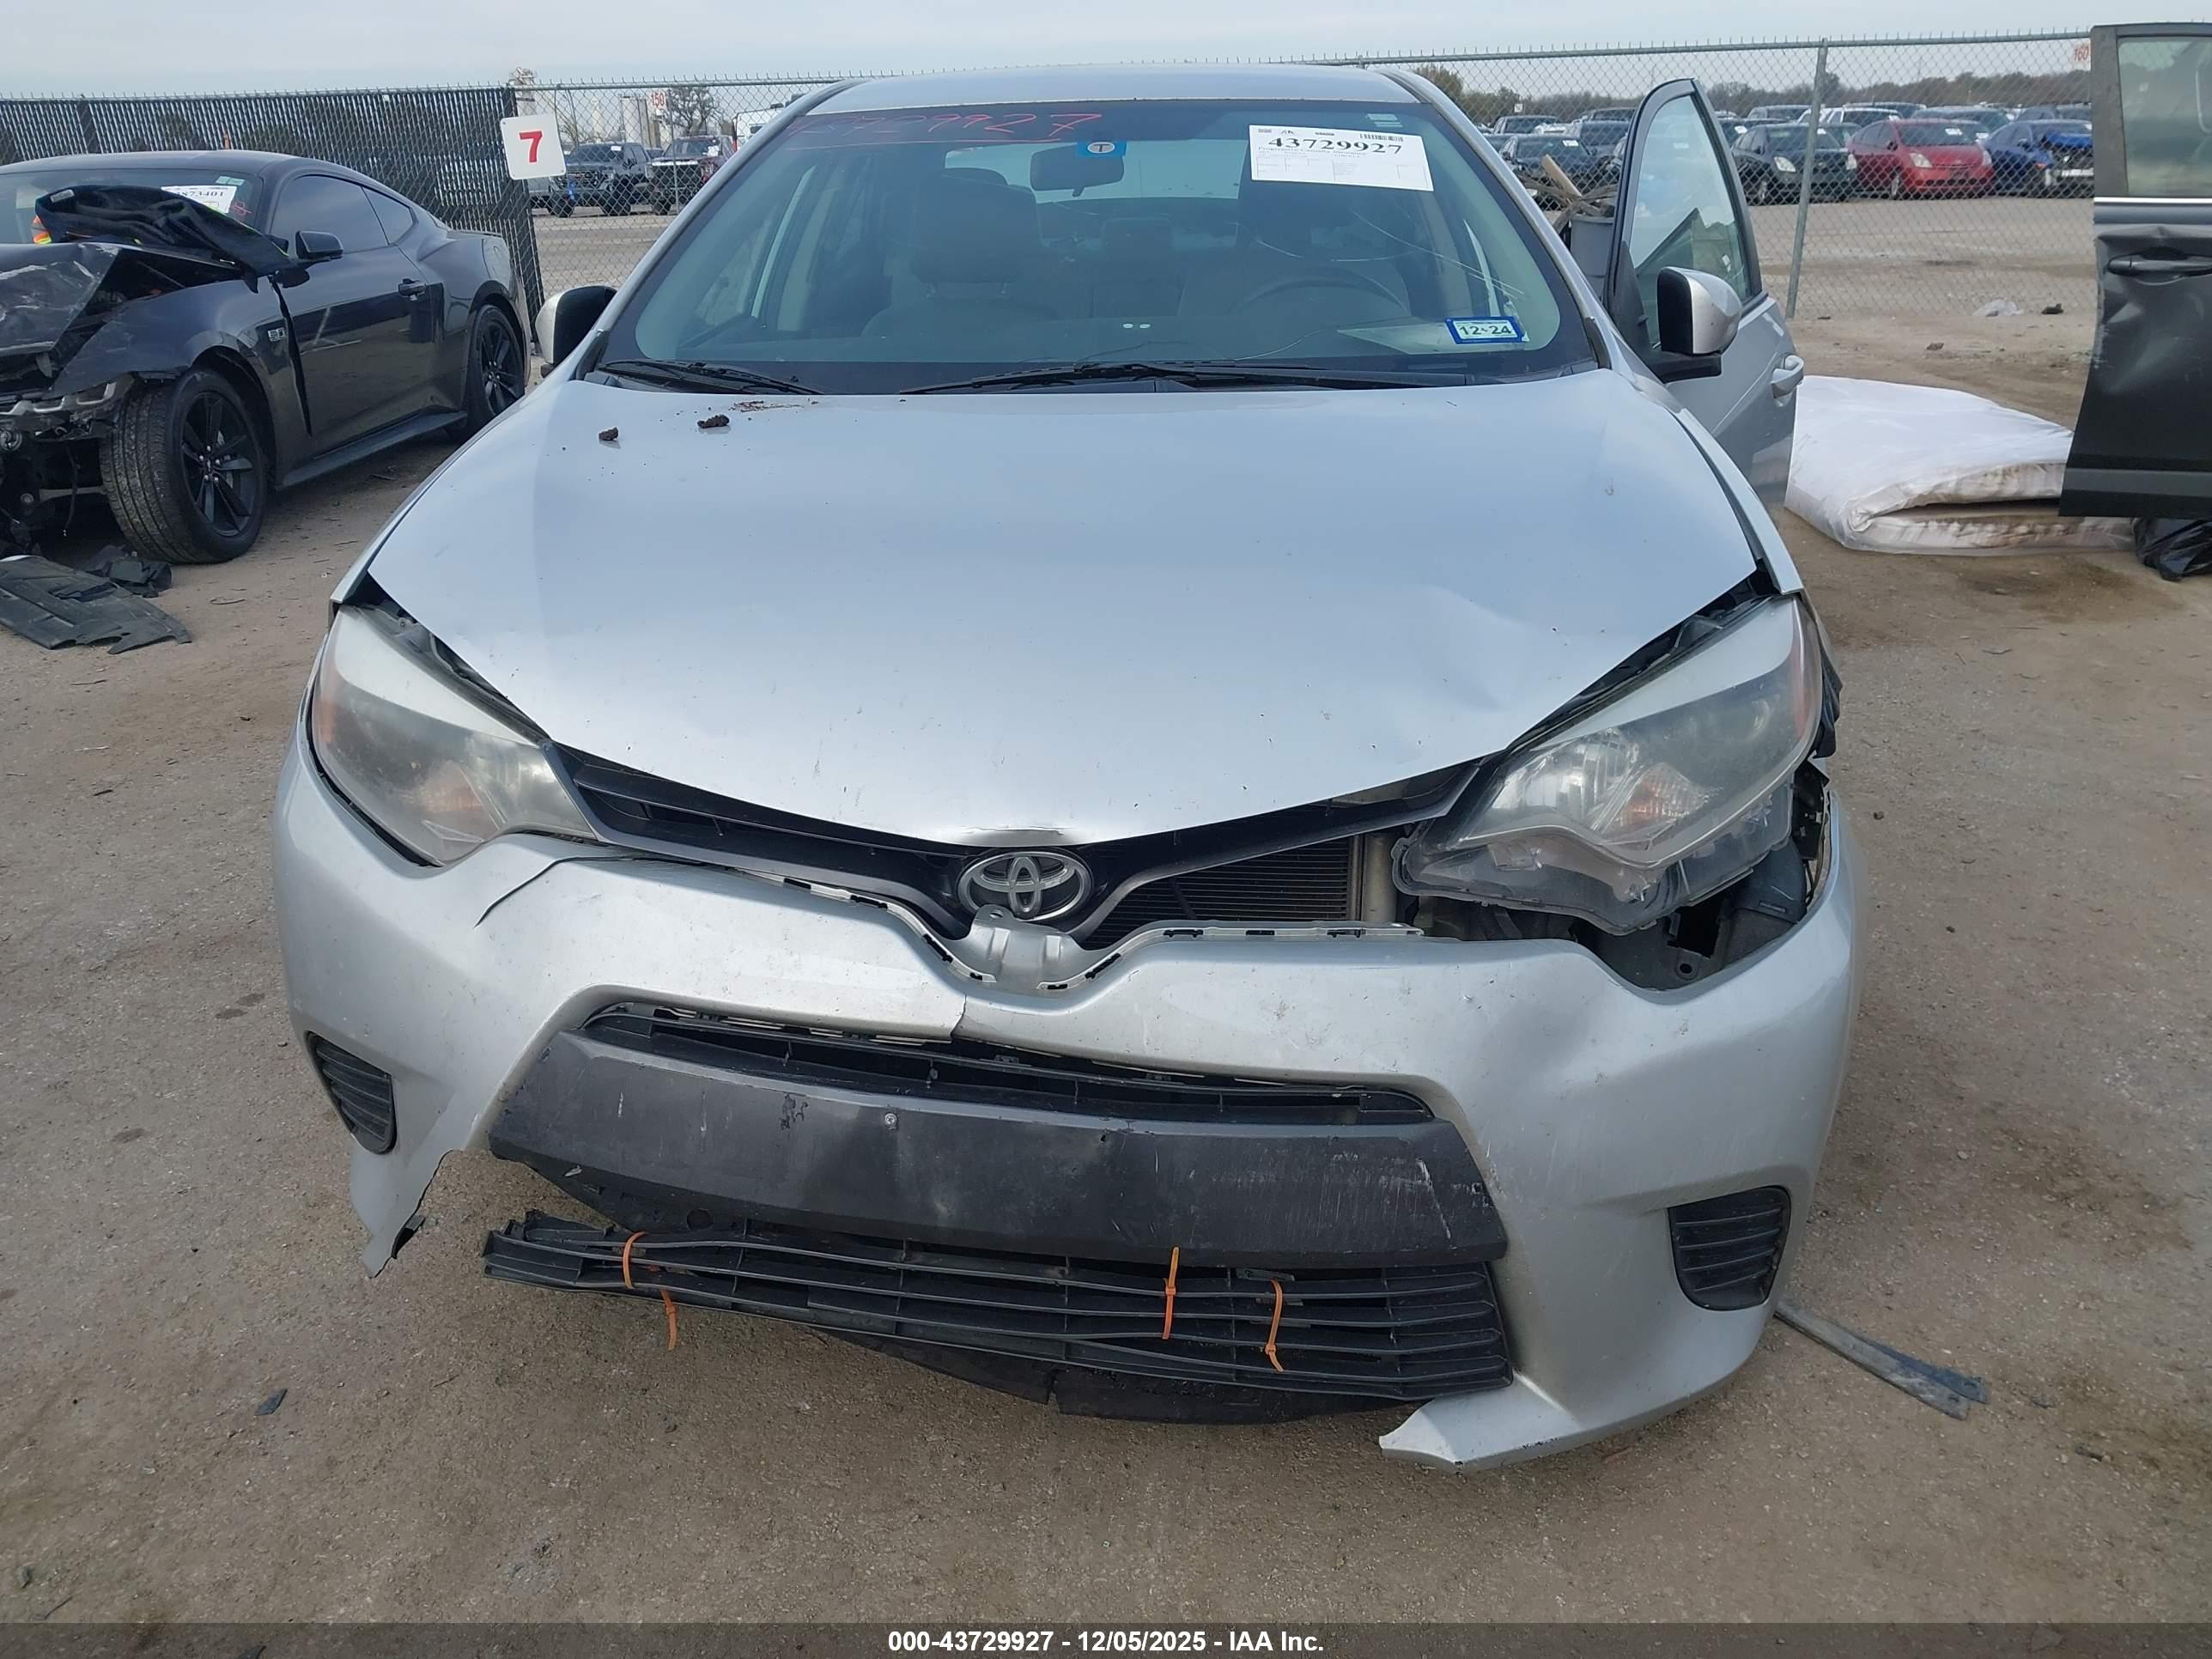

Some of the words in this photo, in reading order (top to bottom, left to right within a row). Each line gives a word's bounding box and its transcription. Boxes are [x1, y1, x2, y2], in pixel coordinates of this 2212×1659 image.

[651, 91, 665, 107] 150
[519, 131, 543, 163] 7
[1268, 137, 1402, 155] 43729927
